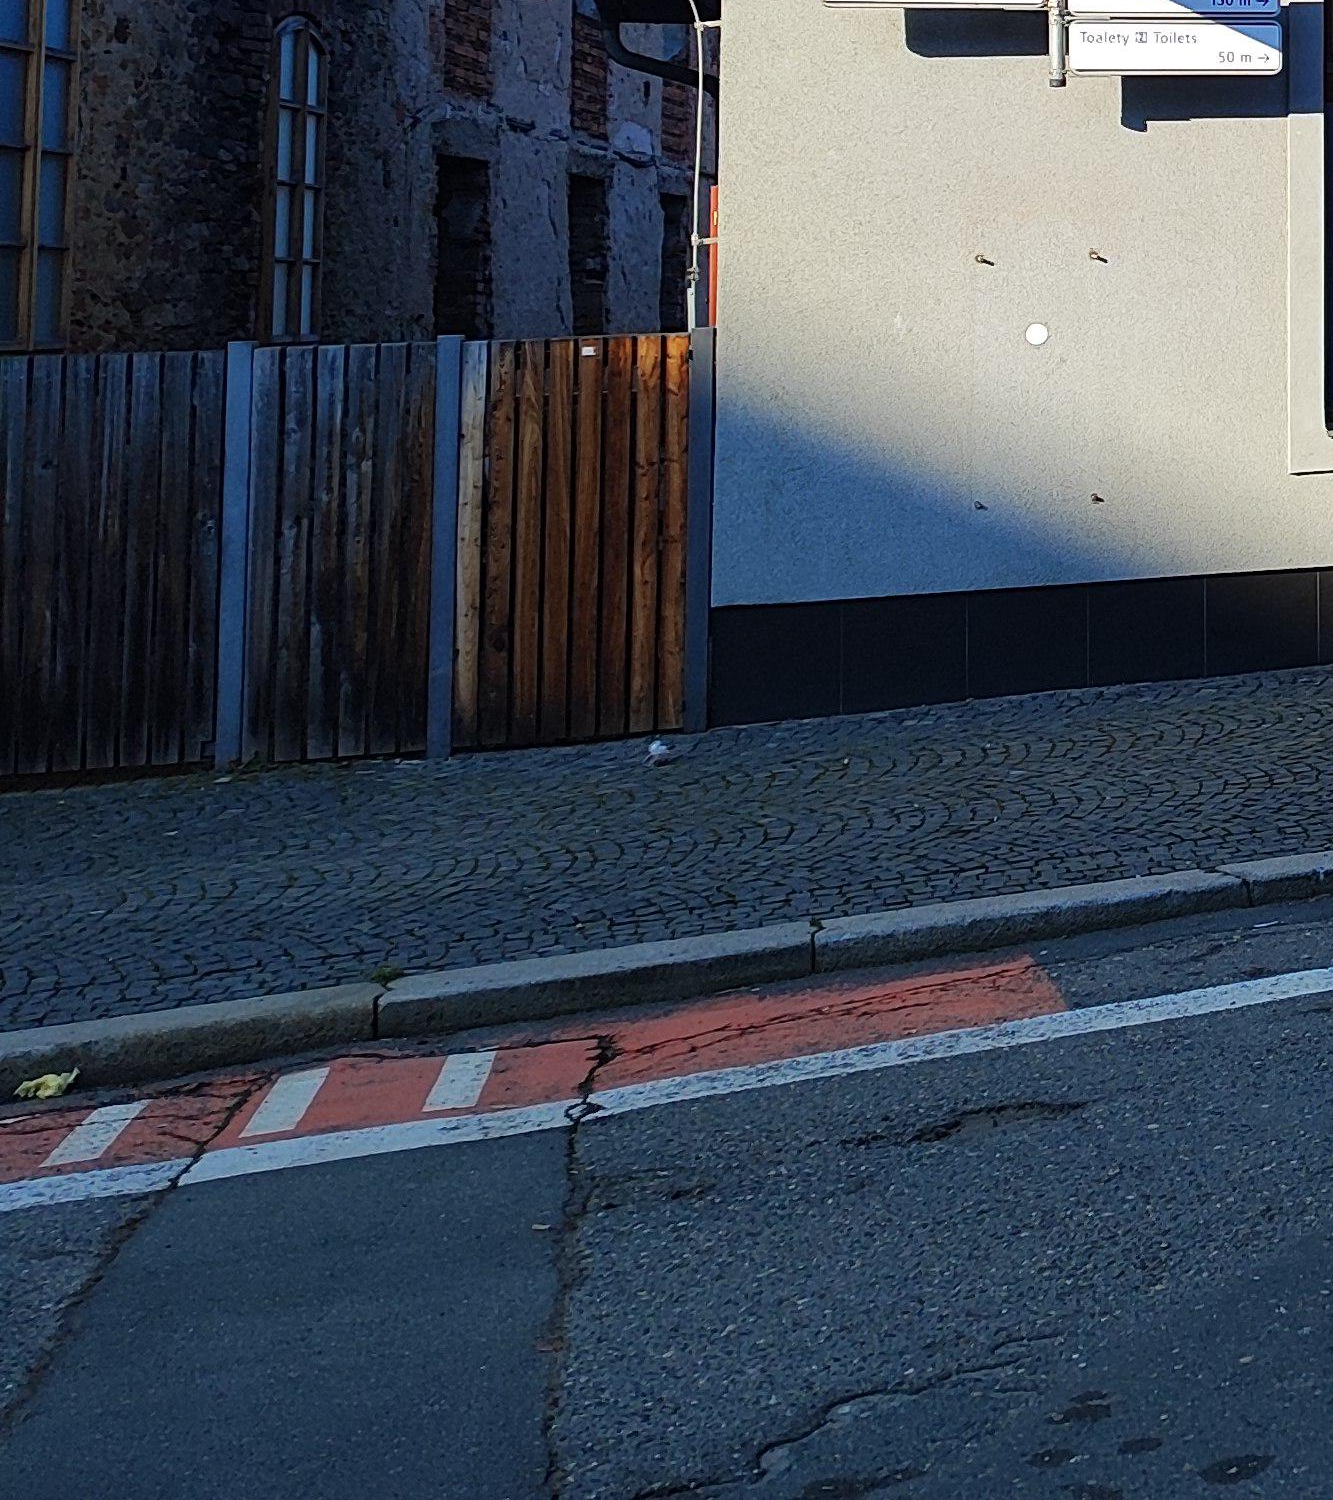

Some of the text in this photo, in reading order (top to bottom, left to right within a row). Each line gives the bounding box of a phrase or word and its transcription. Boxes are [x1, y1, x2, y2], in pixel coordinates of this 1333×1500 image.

[1080, 31, 1197, 46] Toalety Toilets
[1218, 51, 1252, 63] 50 m
